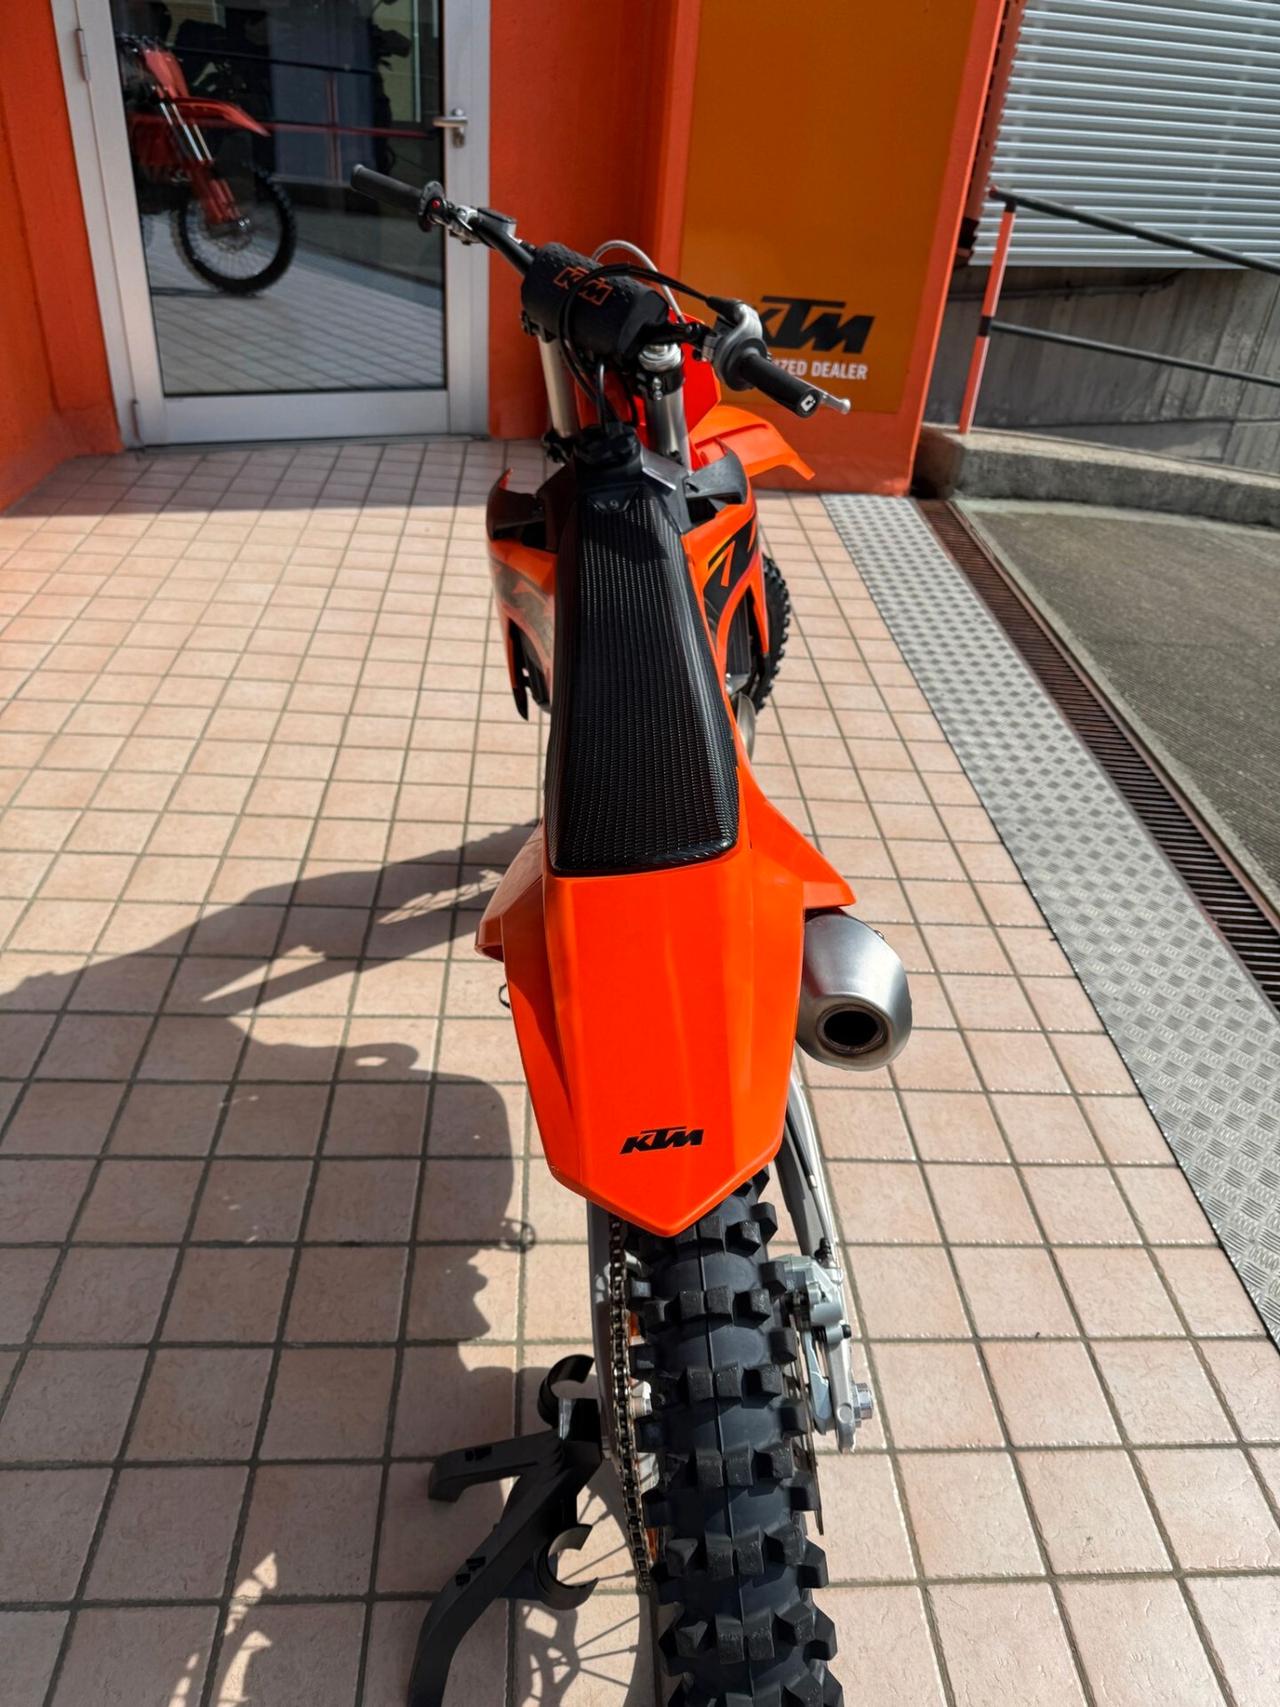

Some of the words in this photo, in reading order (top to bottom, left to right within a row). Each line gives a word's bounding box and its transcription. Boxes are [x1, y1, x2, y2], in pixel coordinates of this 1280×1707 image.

[553, 266, 614, 305] KM
[811, 361, 868, 380] DEALER
[620, 1126, 704, 1155] KTM
